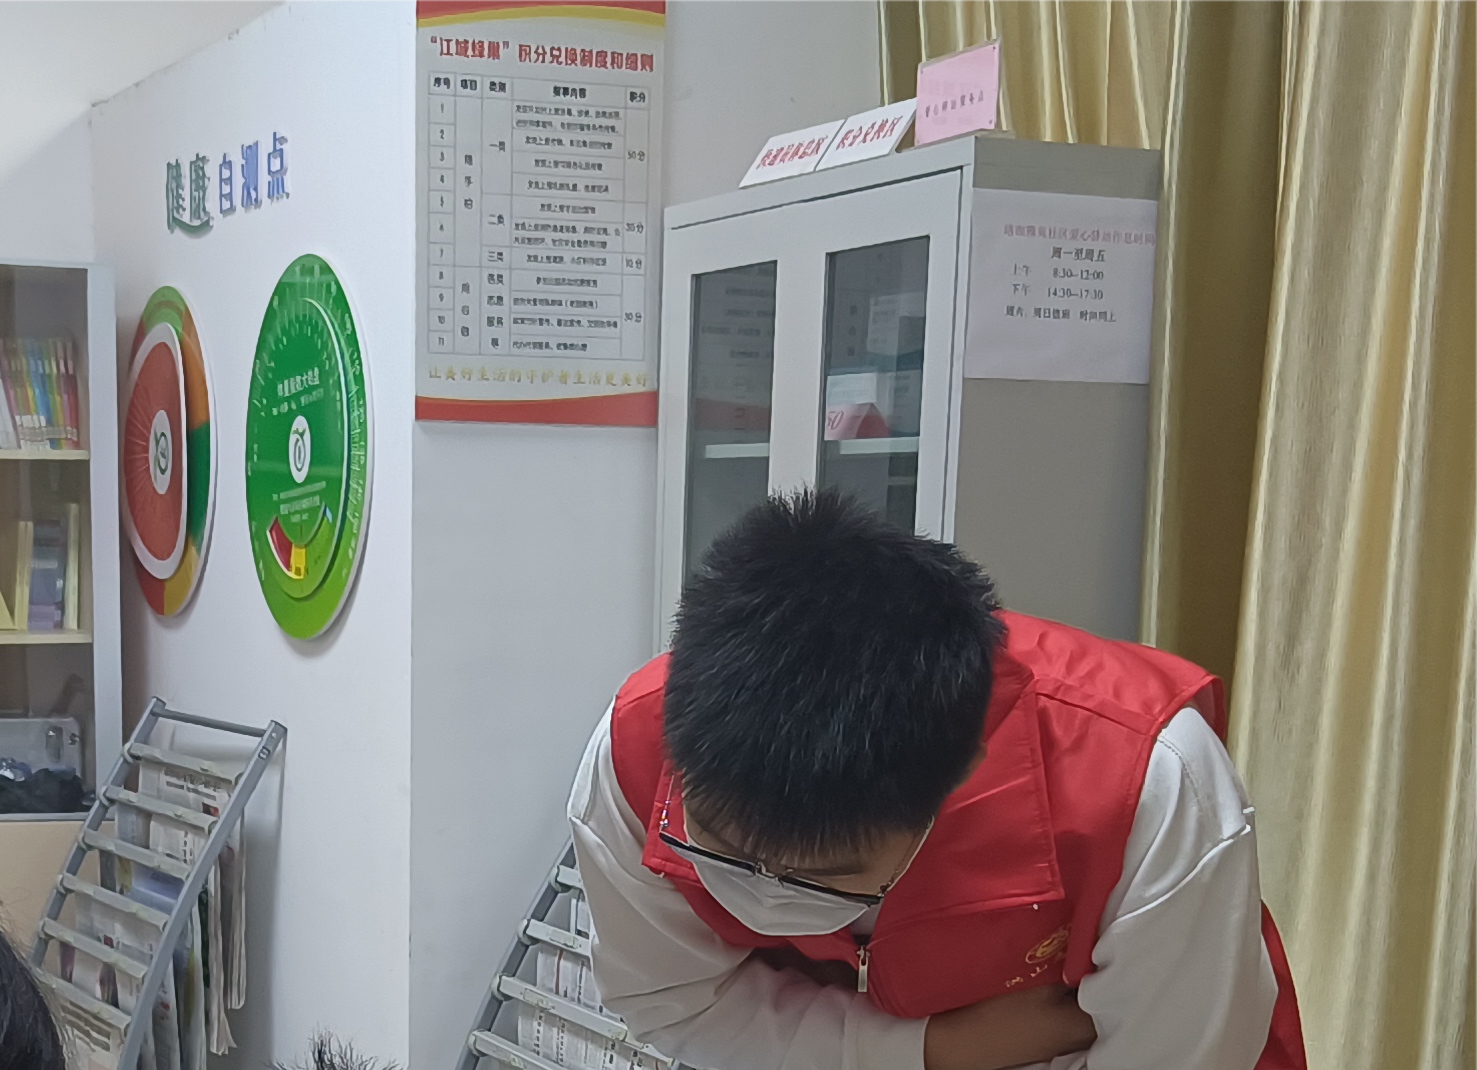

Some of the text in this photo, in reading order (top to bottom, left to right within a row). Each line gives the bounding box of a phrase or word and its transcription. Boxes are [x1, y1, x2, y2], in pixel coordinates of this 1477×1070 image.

[166, 131, 287, 232] 健康自测点
[1051, 246, 1106, 262] 周一至周五
